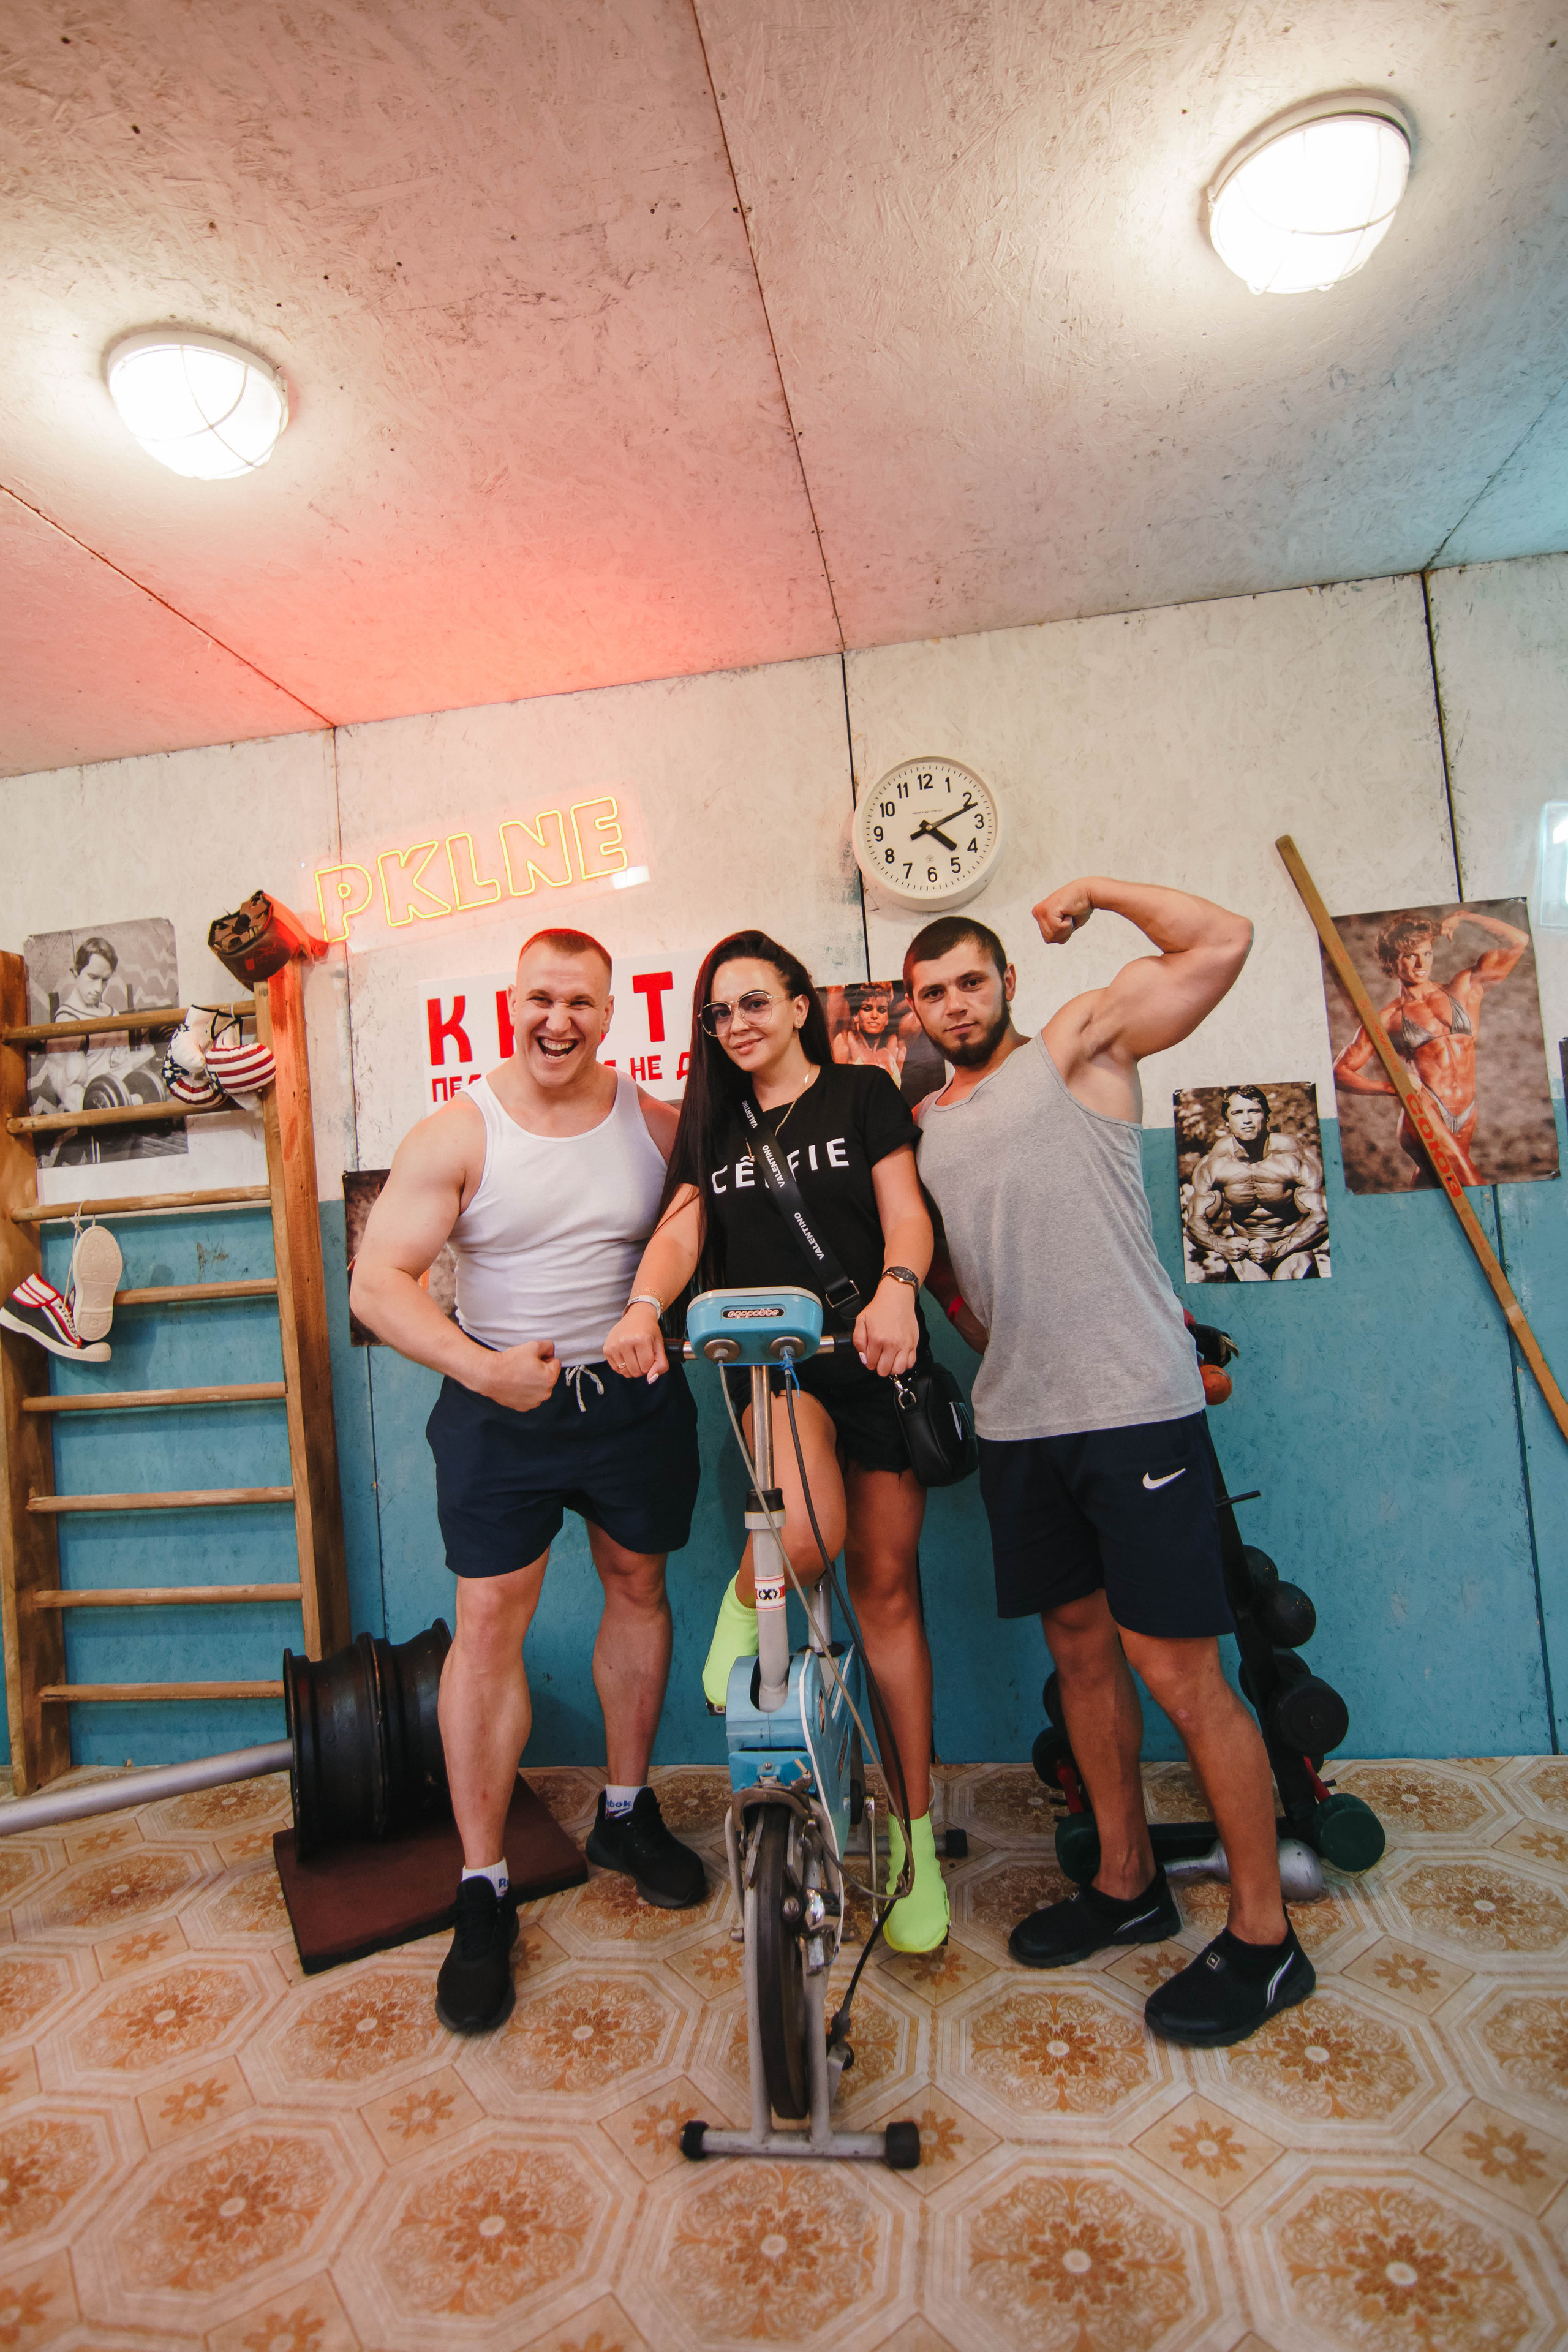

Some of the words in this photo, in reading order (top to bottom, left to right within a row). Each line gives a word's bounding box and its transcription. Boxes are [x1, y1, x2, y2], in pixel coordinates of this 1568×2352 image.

[897, 782, 909, 799] 11
[917, 774, 933, 790] 12
[945, 777, 951, 793] 1
[962, 791, 973, 809] 2
[879, 801, 895, 818] 10
[974, 813, 984, 829] 3
[873, 826, 884, 842] 9
[967, 837, 978, 853] 4
[884, 848, 895, 864] 8
[315, 796, 628, 942] PKLNE
[903, 862, 913, 879] 7
[950, 857, 961, 873] 5
[927, 867, 938, 883] 6
[630, 1055, 663, 1081] НЕ
[742, 1100, 758, 1128] VALENTINO
[1406, 1093, 1463, 1197] СОЮЗ
[762, 1145, 785, 1188] VALENTINO
[794, 1212, 824, 1260] VALENTINO
